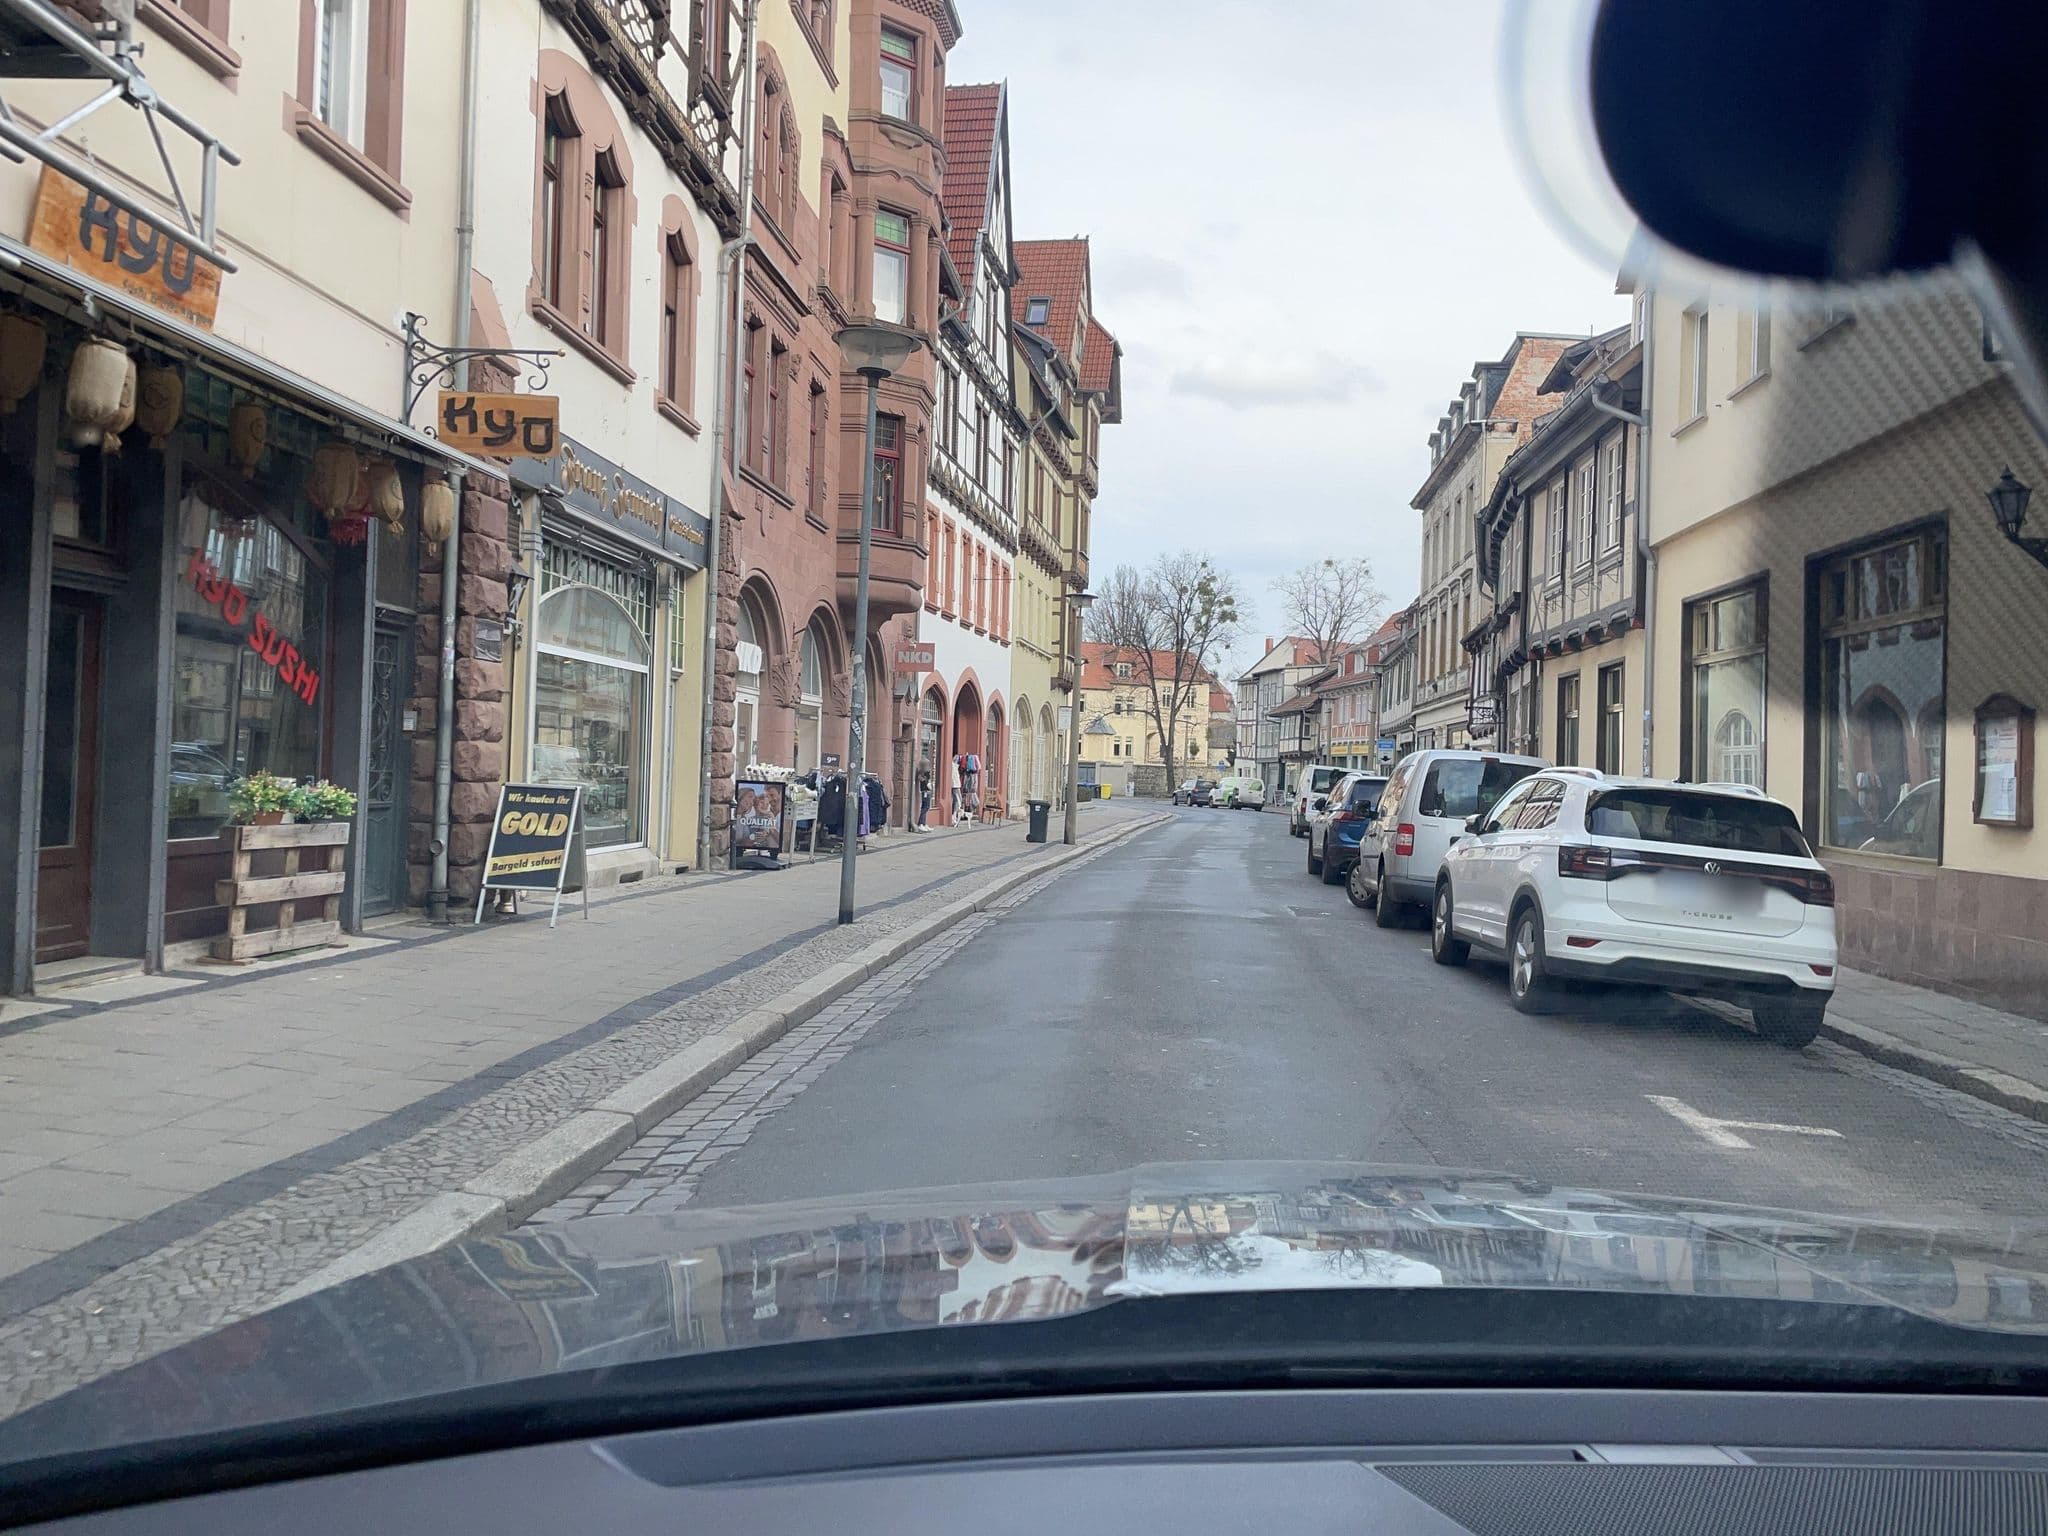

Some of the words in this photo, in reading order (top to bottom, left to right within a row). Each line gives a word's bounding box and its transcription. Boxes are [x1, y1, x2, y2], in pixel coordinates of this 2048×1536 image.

[248, 612, 320, 706] SUSHI
[898, 650, 933, 664] NKD
[508, 793, 524, 802] Wir
[525, 793, 555, 804] kaufen
[501, 811, 568, 837] GOLD
[491, 859, 529, 873] Bargeld
[530, 856, 562, 867] sofort!
